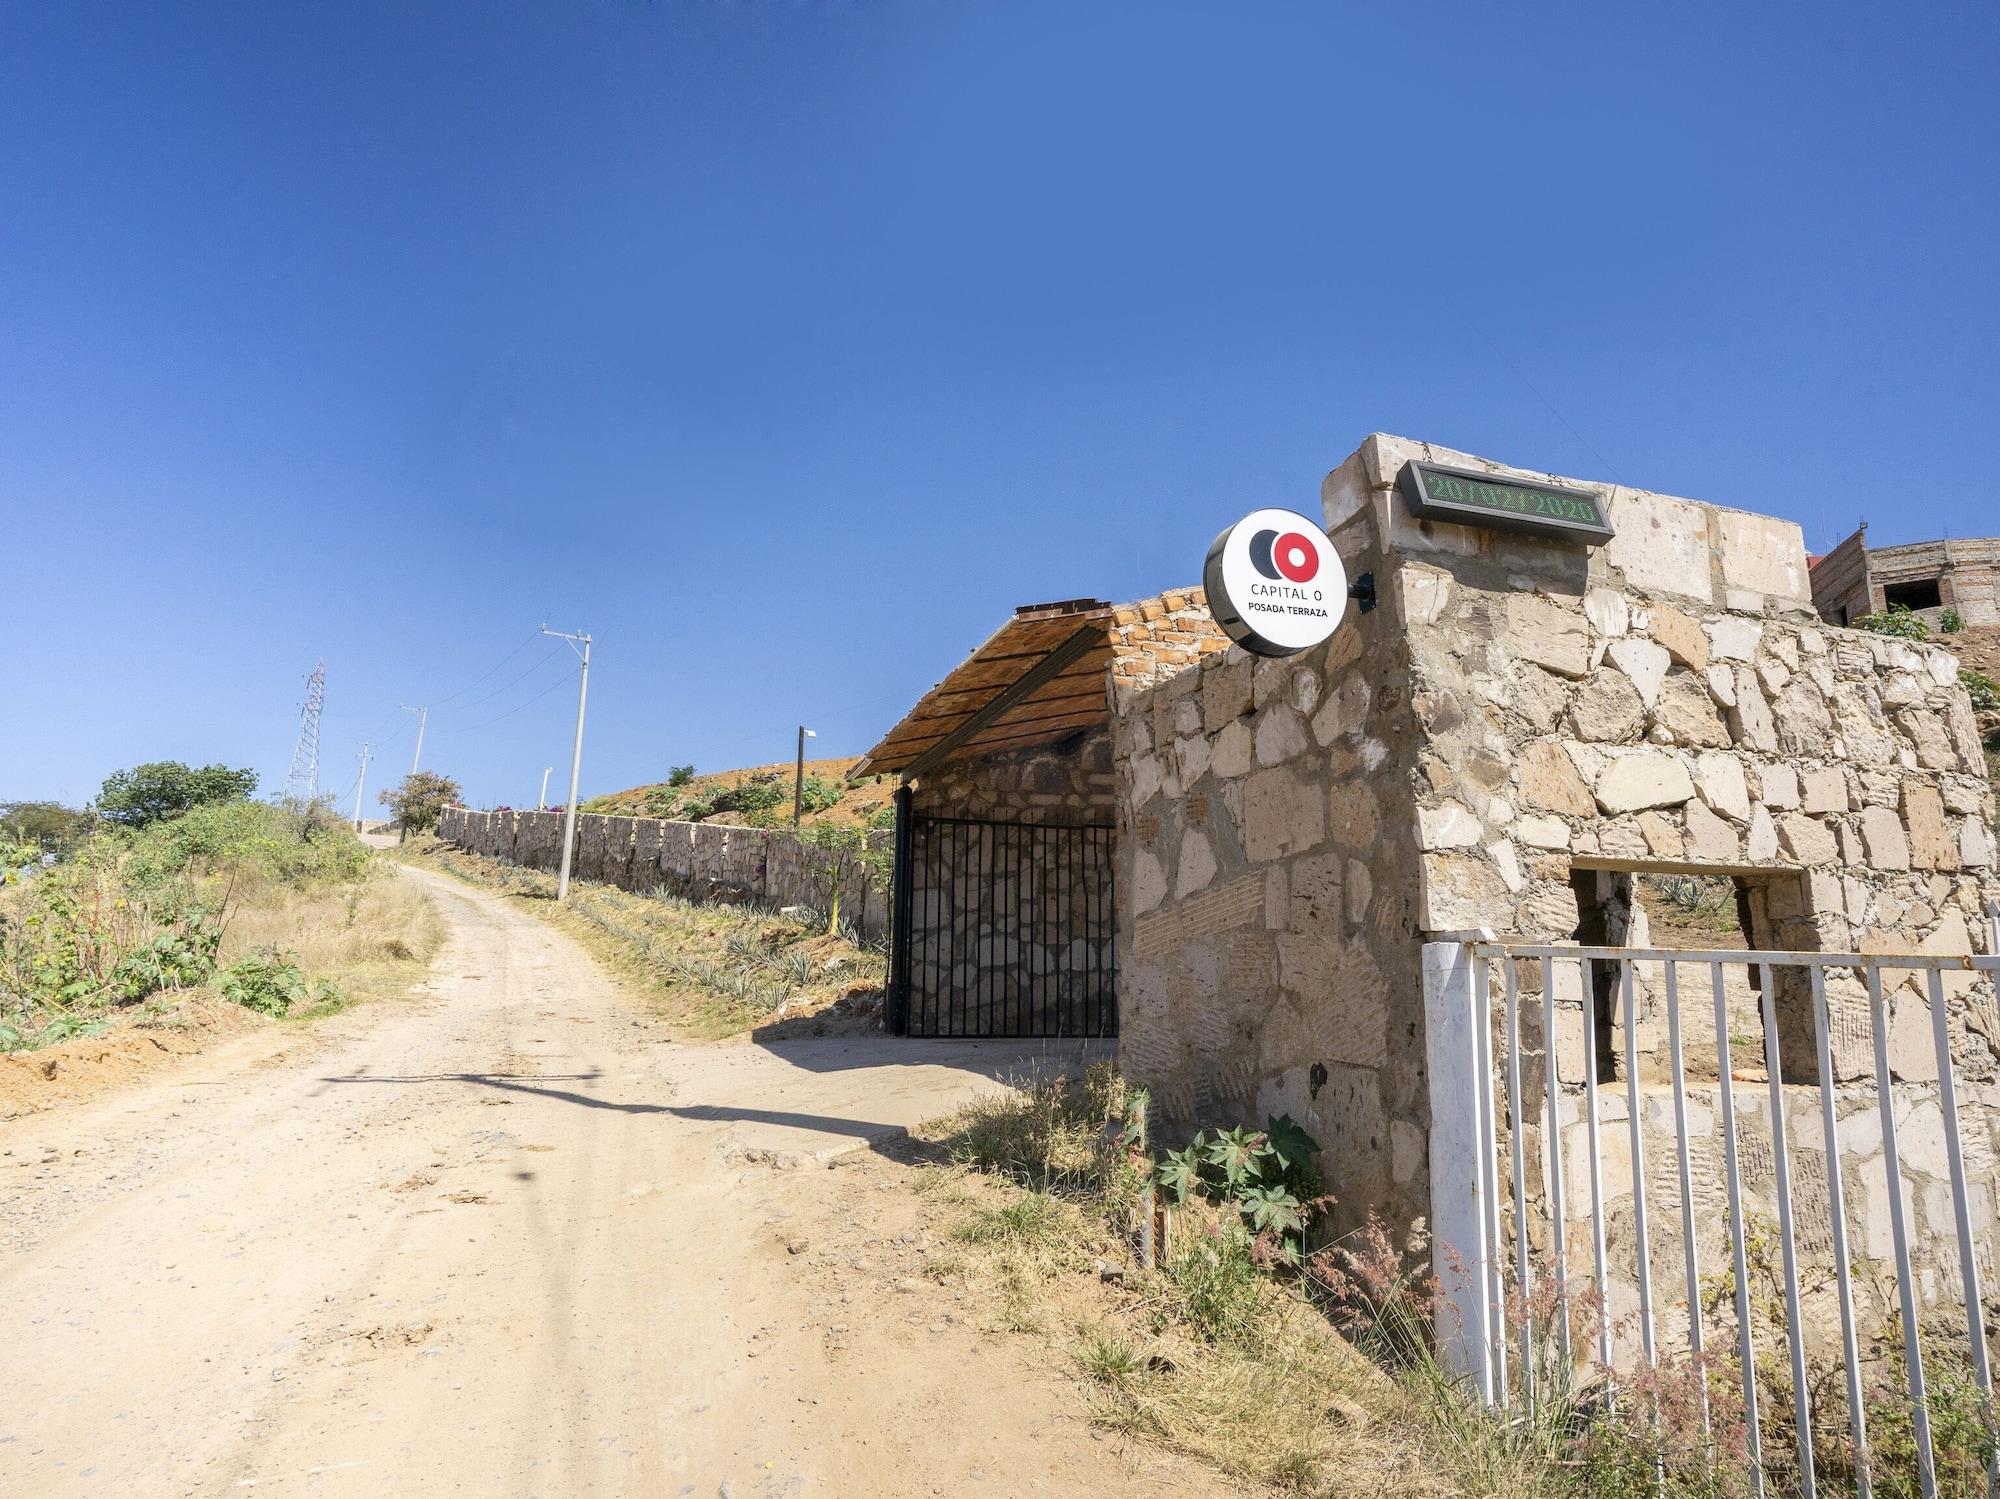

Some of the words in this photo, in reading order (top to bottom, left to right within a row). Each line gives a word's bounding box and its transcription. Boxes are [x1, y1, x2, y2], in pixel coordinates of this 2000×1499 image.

[1251, 583, 1308, 600] CAPITAL
[1313, 590, 1322, 601] O
[1248, 602, 1285, 614] POSADA
[1287, 606, 1328, 618] TERRAZA
